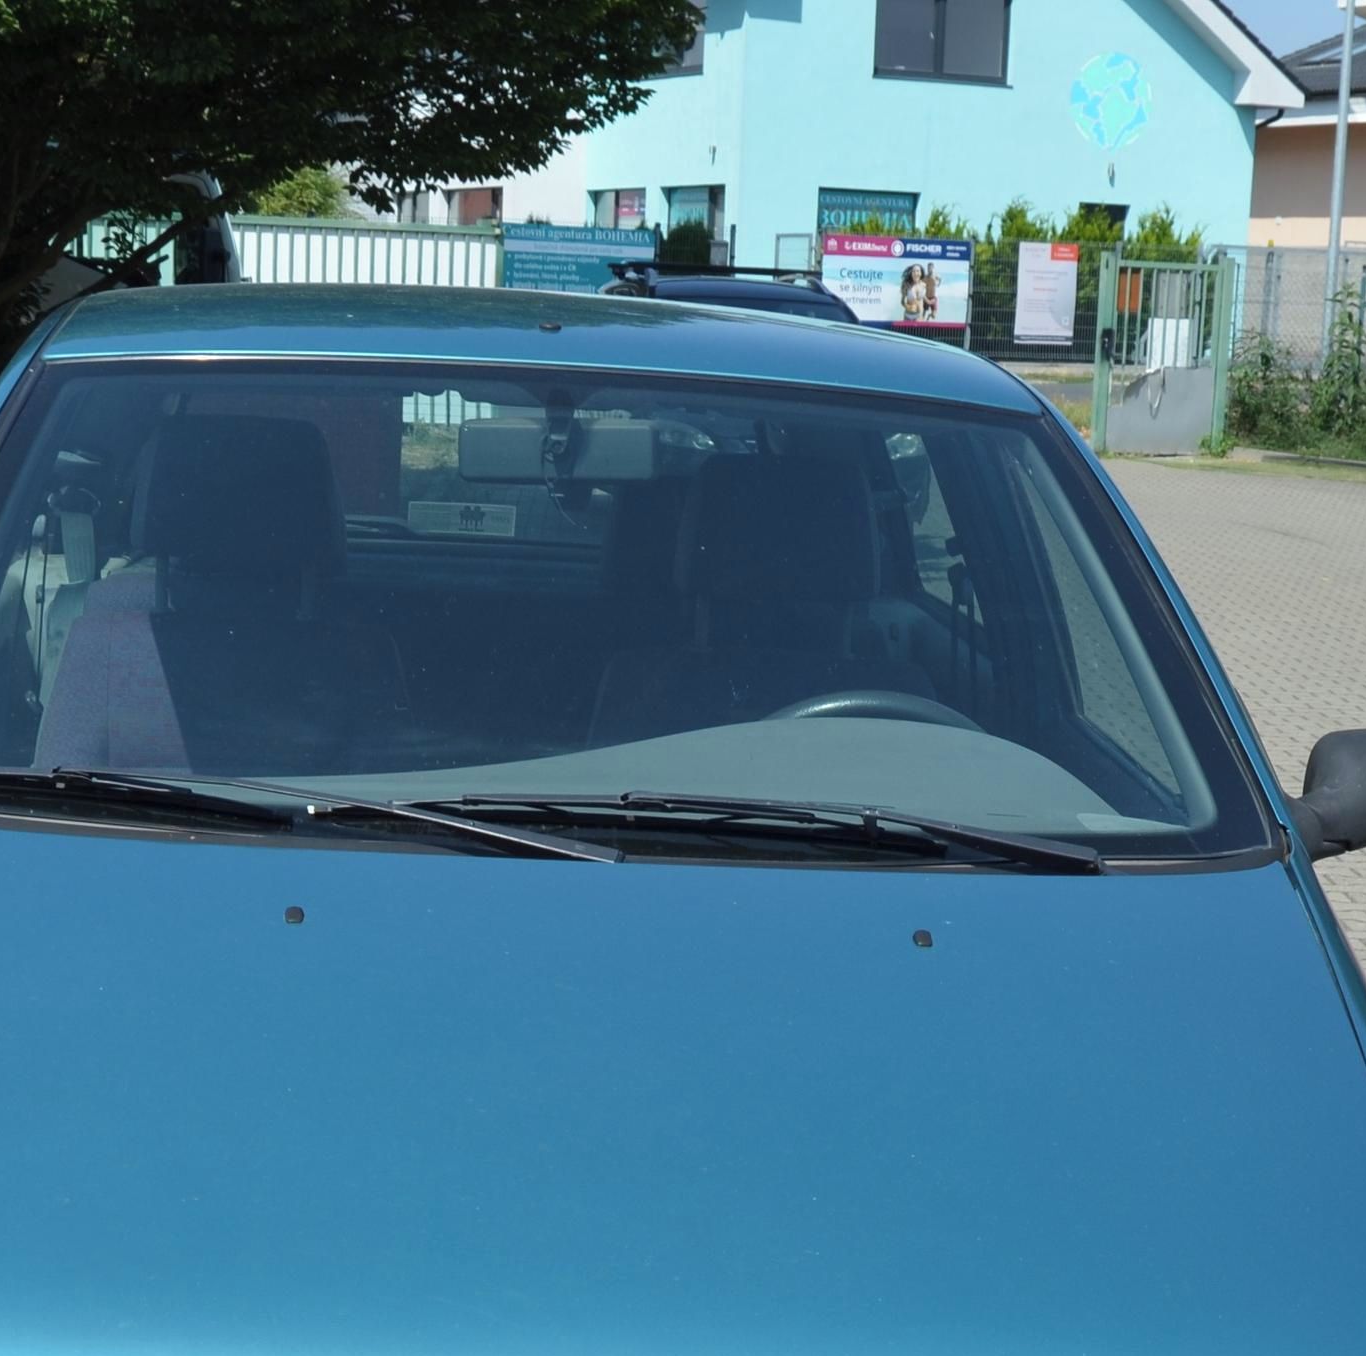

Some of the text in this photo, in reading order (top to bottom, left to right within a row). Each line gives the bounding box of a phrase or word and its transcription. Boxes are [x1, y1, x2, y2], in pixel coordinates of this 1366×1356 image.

[548, 228, 592, 241] agentura
[595, 229, 650, 243] BOHEMIA
[906, 243, 942, 253] FISCHER
[839, 267, 884, 282] Cestujte
[851, 283, 883, 294] silným
